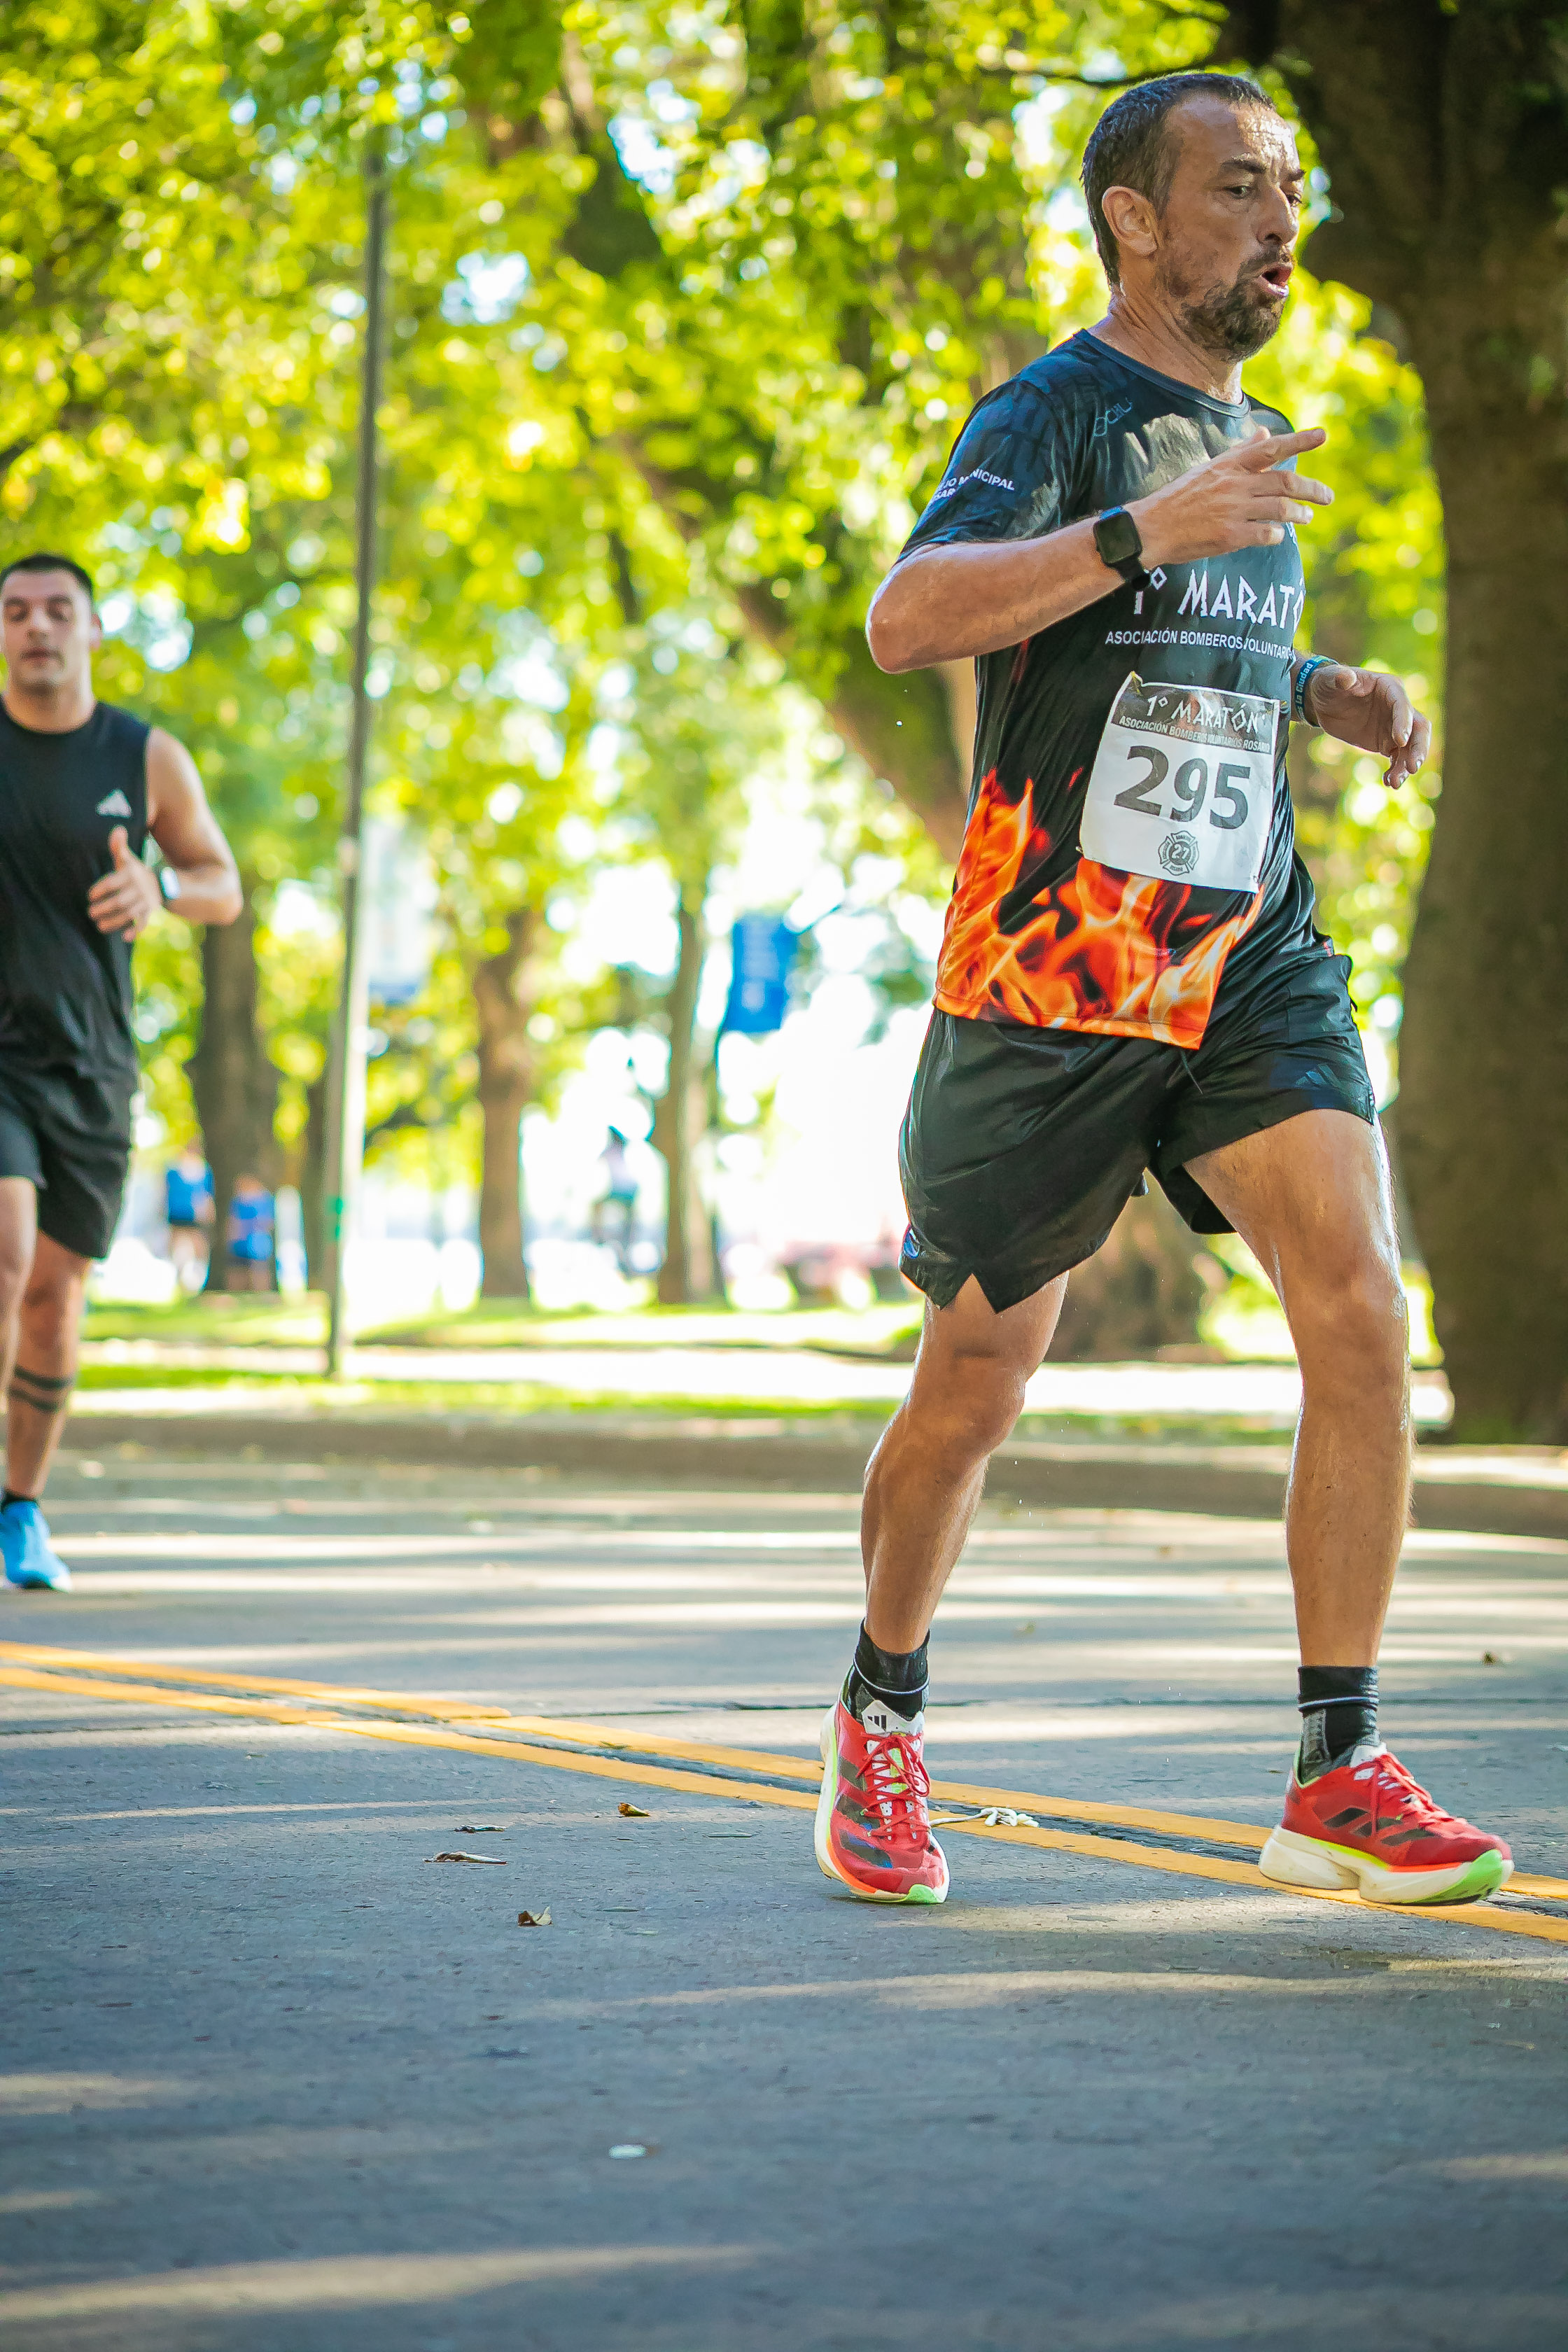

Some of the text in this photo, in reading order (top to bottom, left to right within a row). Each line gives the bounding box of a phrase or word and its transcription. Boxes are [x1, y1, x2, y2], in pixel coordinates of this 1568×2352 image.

[958, 468, 1014, 491] MNICIPAL
[1177, 568, 1305, 633] MARATÓ
[1105, 626, 1177, 645] ASOCIACIÓN
[1180, 630, 1244, 650] BOMBEROS
[1296, 662, 1314, 693] Ciudad
[1171, 699, 1258, 734] MARATÓN
[1119, 715, 1270, 753] ASOCIACIÓN BOMBEROS VOLUNTARIOS ROSARIO
[1114, 745, 1251, 830] 295
[1171, 844, 1190, 860] 27
